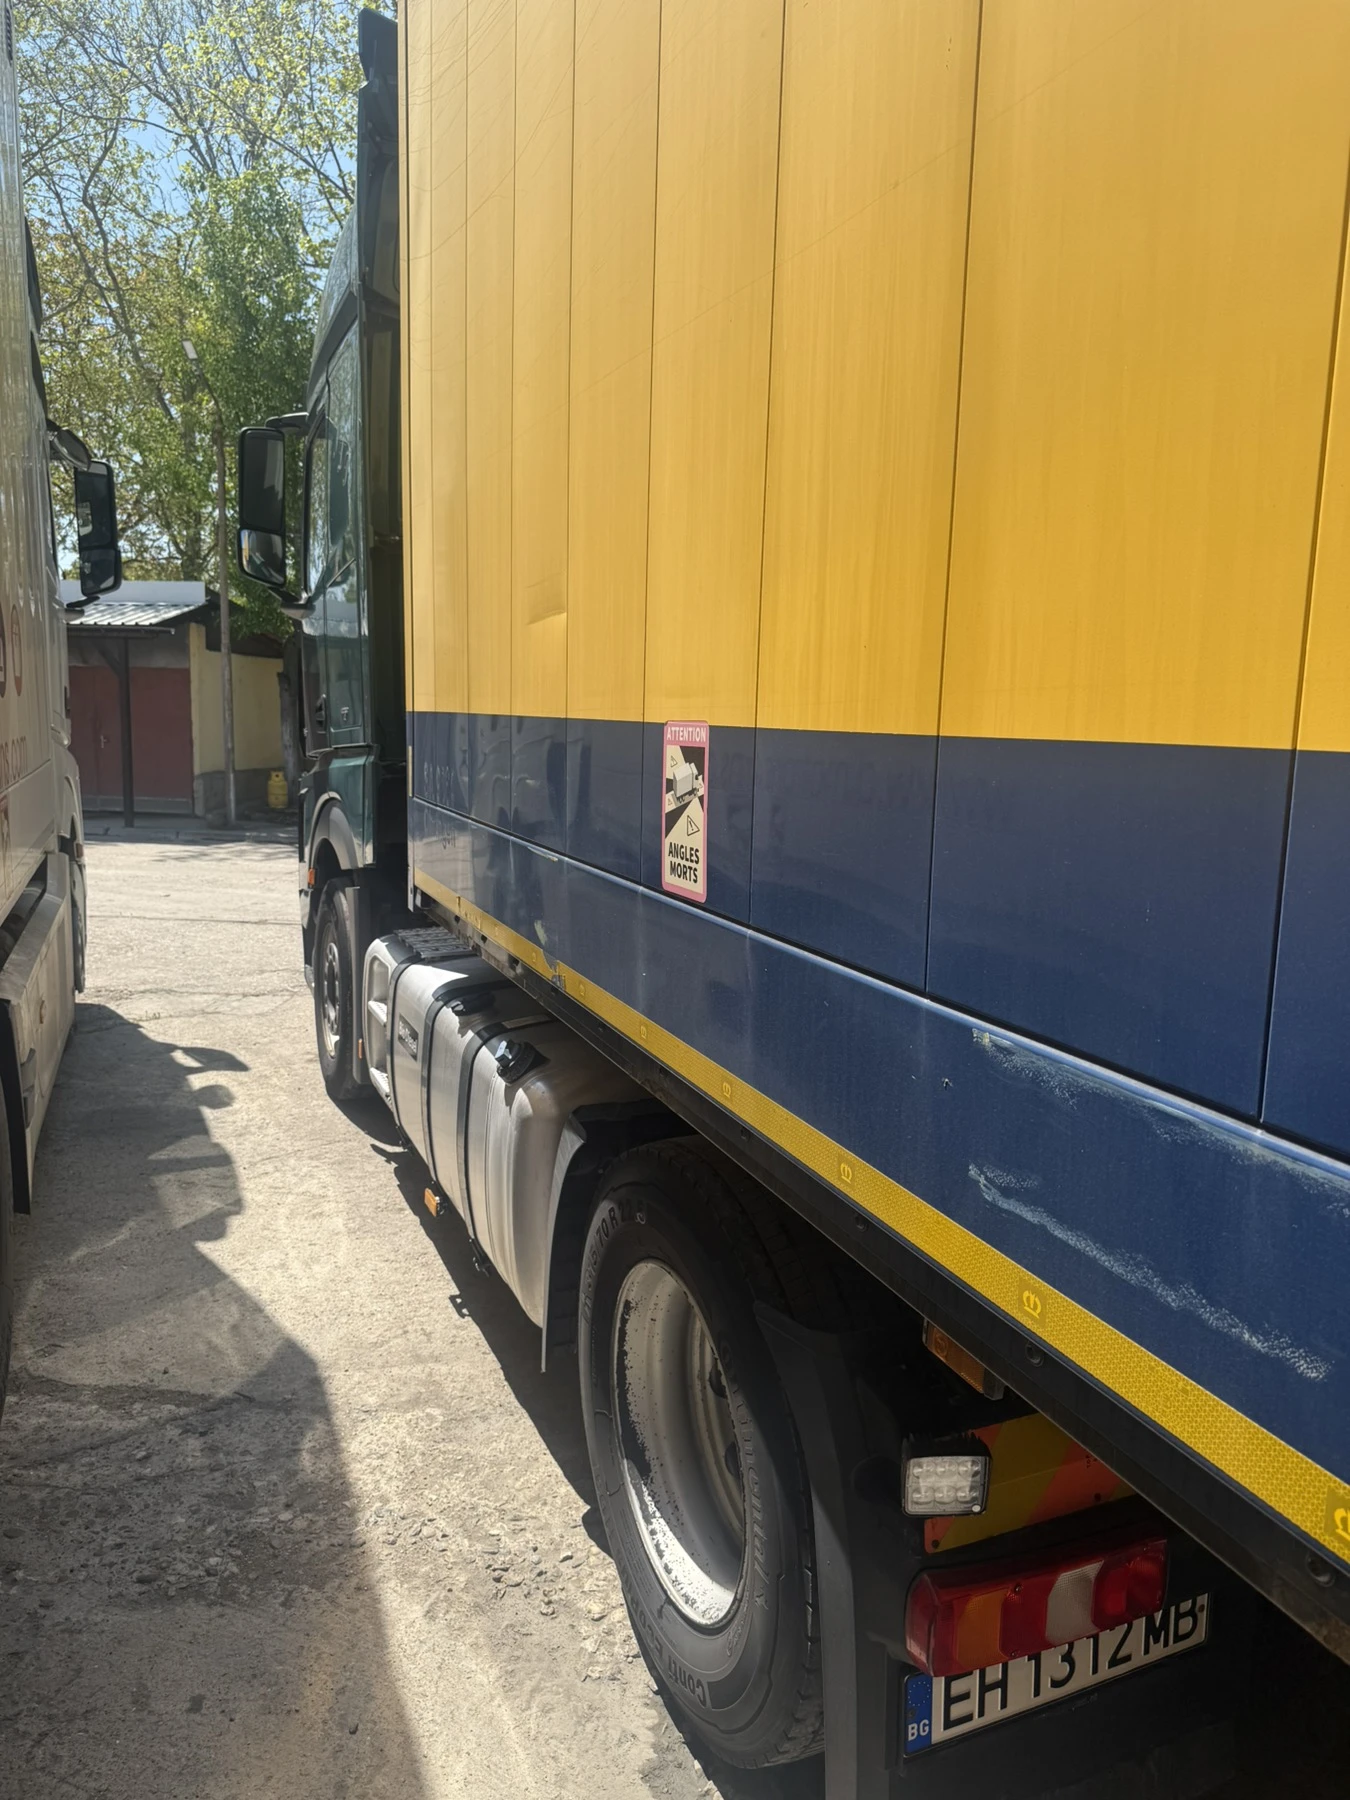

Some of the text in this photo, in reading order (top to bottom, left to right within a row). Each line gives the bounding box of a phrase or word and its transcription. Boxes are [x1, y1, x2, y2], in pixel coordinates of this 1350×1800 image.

[666, 726, 707, 743] ATTENTION
[668, 841, 700, 865] ANGLES
[669, 860, 699, 884] MORTS
[942, 1598, 1199, 1732] EH 1312 MB
[668, 1654, 708, 1708] Conti
[907, 1718, 930, 1742] BG
